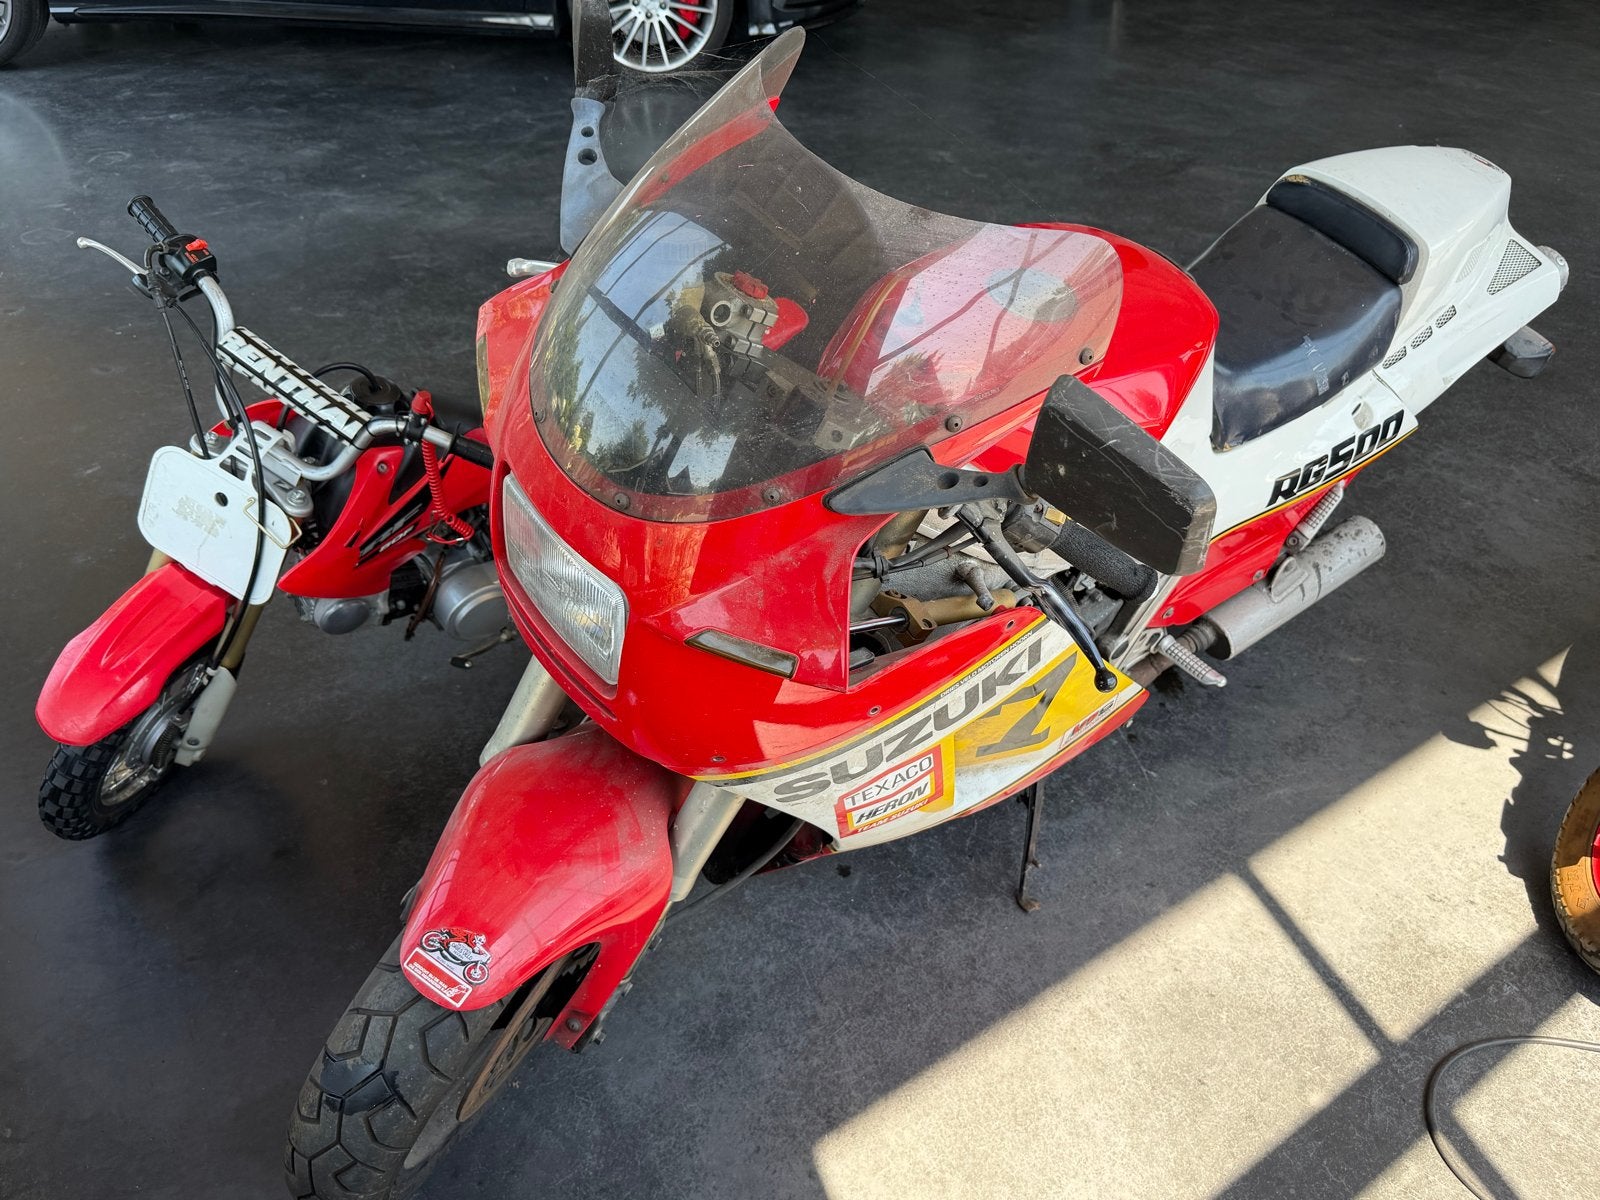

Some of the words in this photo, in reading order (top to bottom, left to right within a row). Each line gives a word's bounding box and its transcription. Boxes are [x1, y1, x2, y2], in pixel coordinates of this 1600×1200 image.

[1265, 408, 1405, 508] RG500
[941, 682, 959, 698] DRIES
[960, 671, 976, 684] VELD
[977, 648, 1009, 674] MOTOREN
[1009, 630, 1032, 650] HOORN
[774, 637, 1042, 802] SUZUKI
[845, 756, 932, 806] TEXACO
[855, 781, 929, 824] HERON
[858, 817, 889, 833] TEAM
[891, 798, 929, 819] SUZUKI
